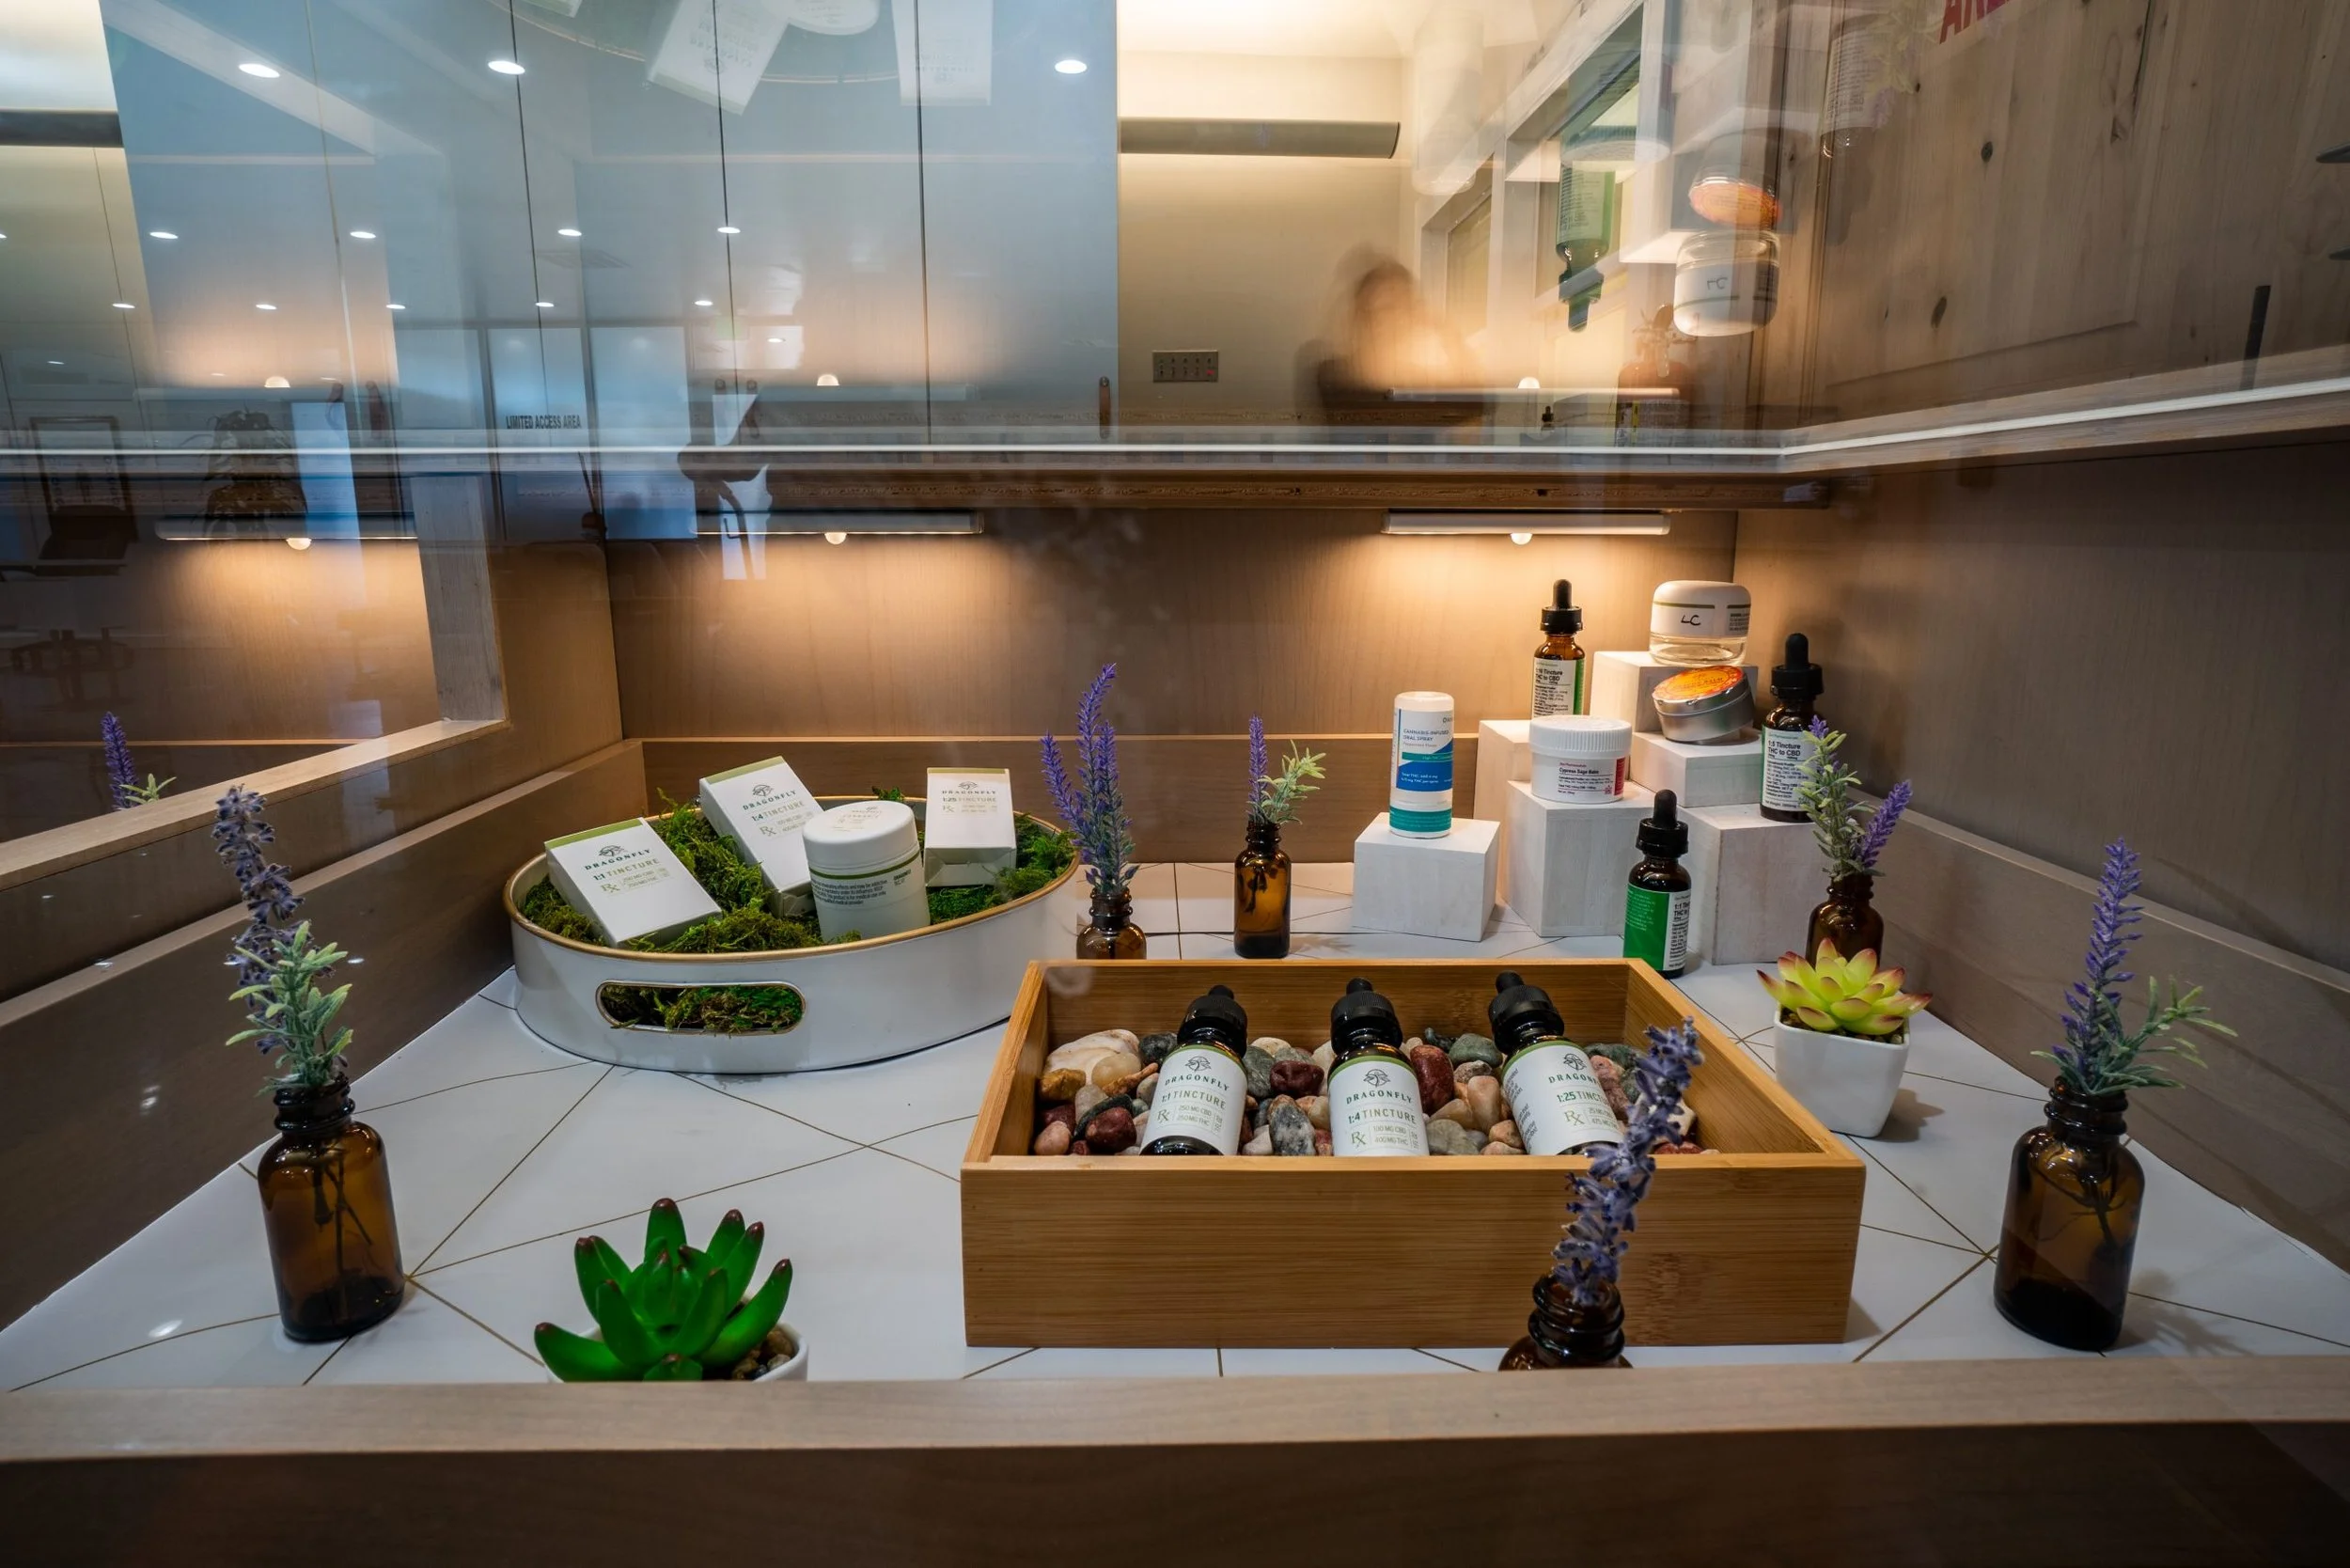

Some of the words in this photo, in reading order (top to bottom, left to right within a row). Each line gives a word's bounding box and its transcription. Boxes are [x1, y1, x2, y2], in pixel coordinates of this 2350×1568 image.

[506, 415, 533, 430] LIMITED
[535, 415, 561, 430] ACCESS
[563, 415, 582, 430] AREA
[1767, 746, 1778, 755] THC
[1776, 741, 1801, 749] Tincture
[743, 790, 796, 810] DRAGONFLY
[751, 812, 763, 822] 1:4
[763, 800, 804, 817] TINCTURE
[585, 848, 650, 870] DRAGONFLY
[593, 872, 606, 881] 1:1
[606, 857, 660, 877] TINCTURE
[1165, 1074, 1230, 1091] DRAGONFLY
[1162, 1093, 1170, 1103] 1:1
[1173, 1090, 1227, 1110] TINCTURE
[1346, 1090, 1412, 1105] DRAGONFLY
[1557, 1091, 1576, 1103] 1:25
[1199, 1108, 1212, 1117] CBD
[1348, 1112, 1360, 1124] 1:4
[1362, 1108, 1417, 1124] TINCTURE
[1394, 1126, 1406, 1135] CBD
[1397, 1137, 1408, 1146] THC
